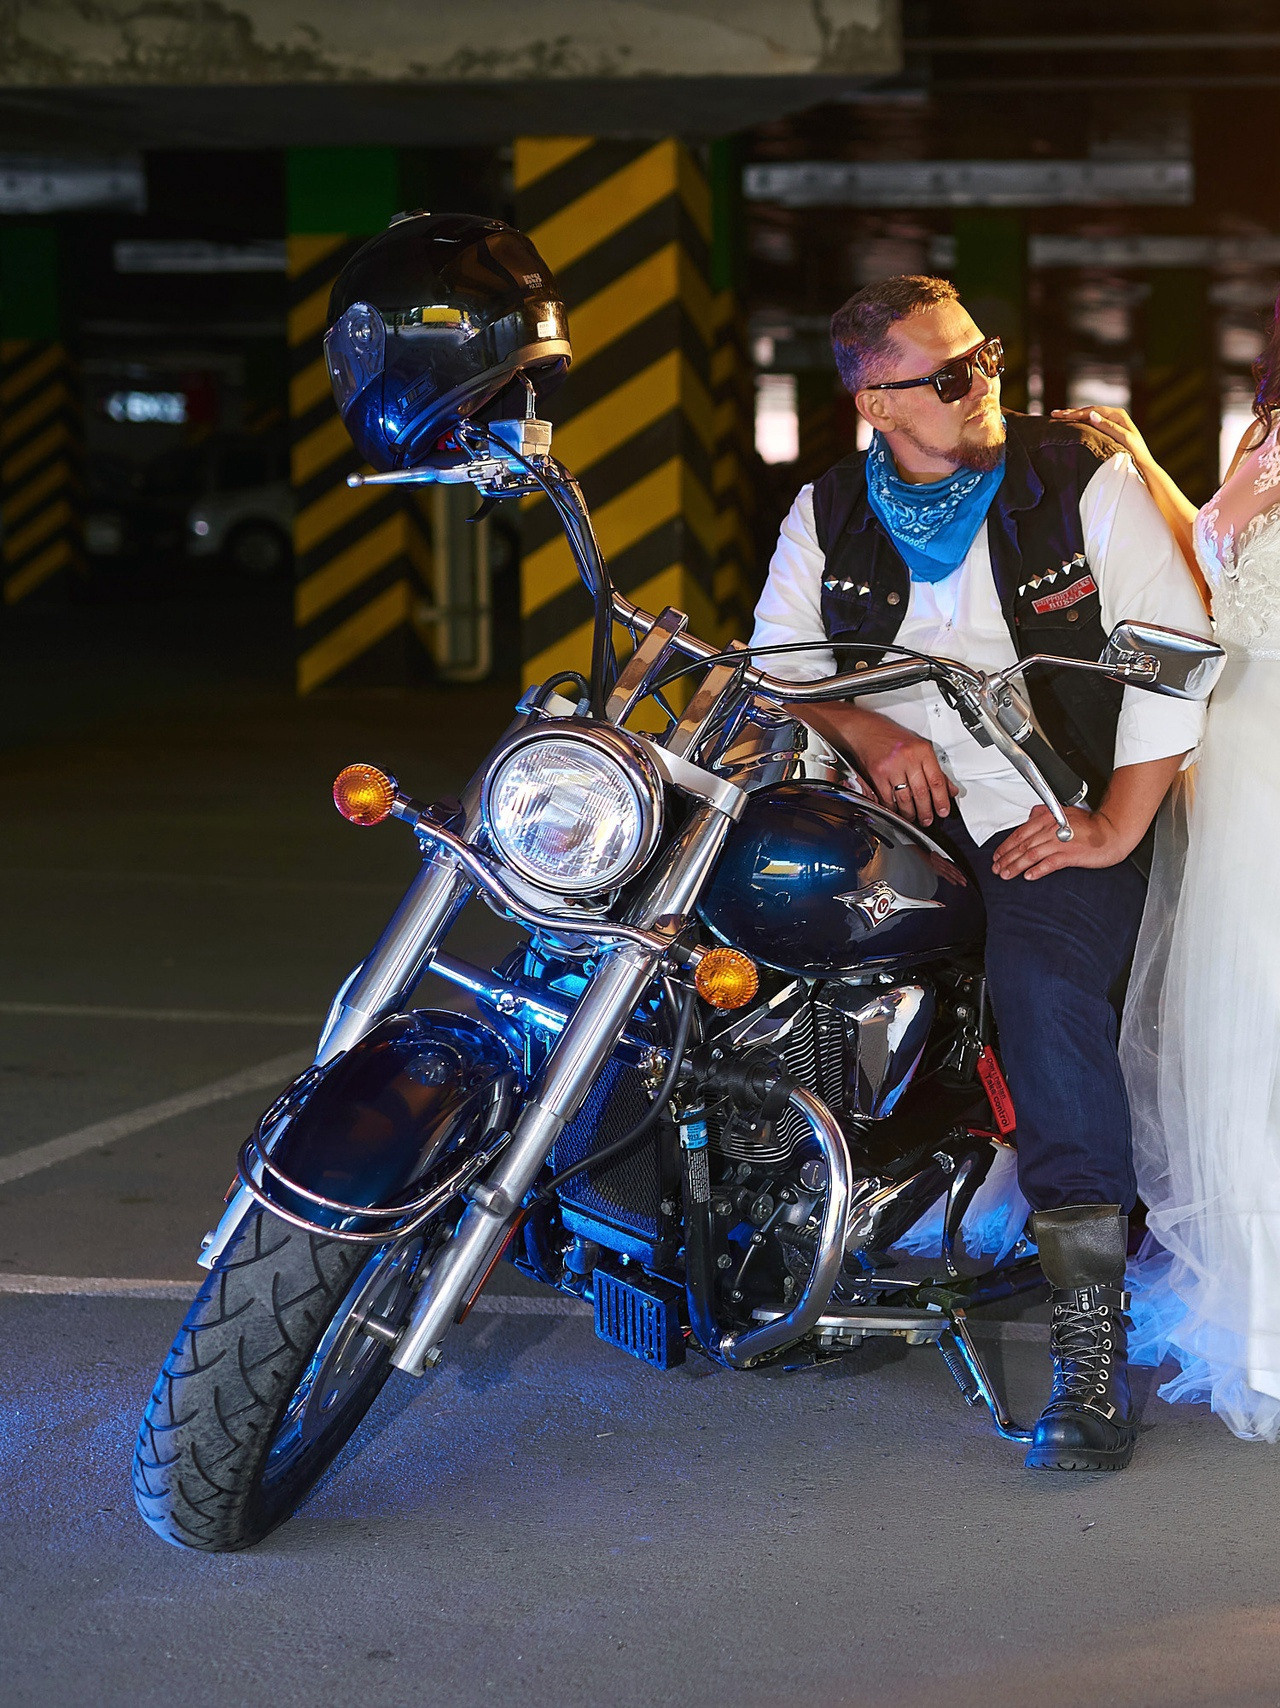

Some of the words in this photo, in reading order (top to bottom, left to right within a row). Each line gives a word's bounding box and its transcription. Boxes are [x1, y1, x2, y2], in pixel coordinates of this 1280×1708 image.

[1049, 590, 1085, 609] RUSSIA
[985, 1073, 996, 1094] Take
[994, 1096, 1010, 1128] control
